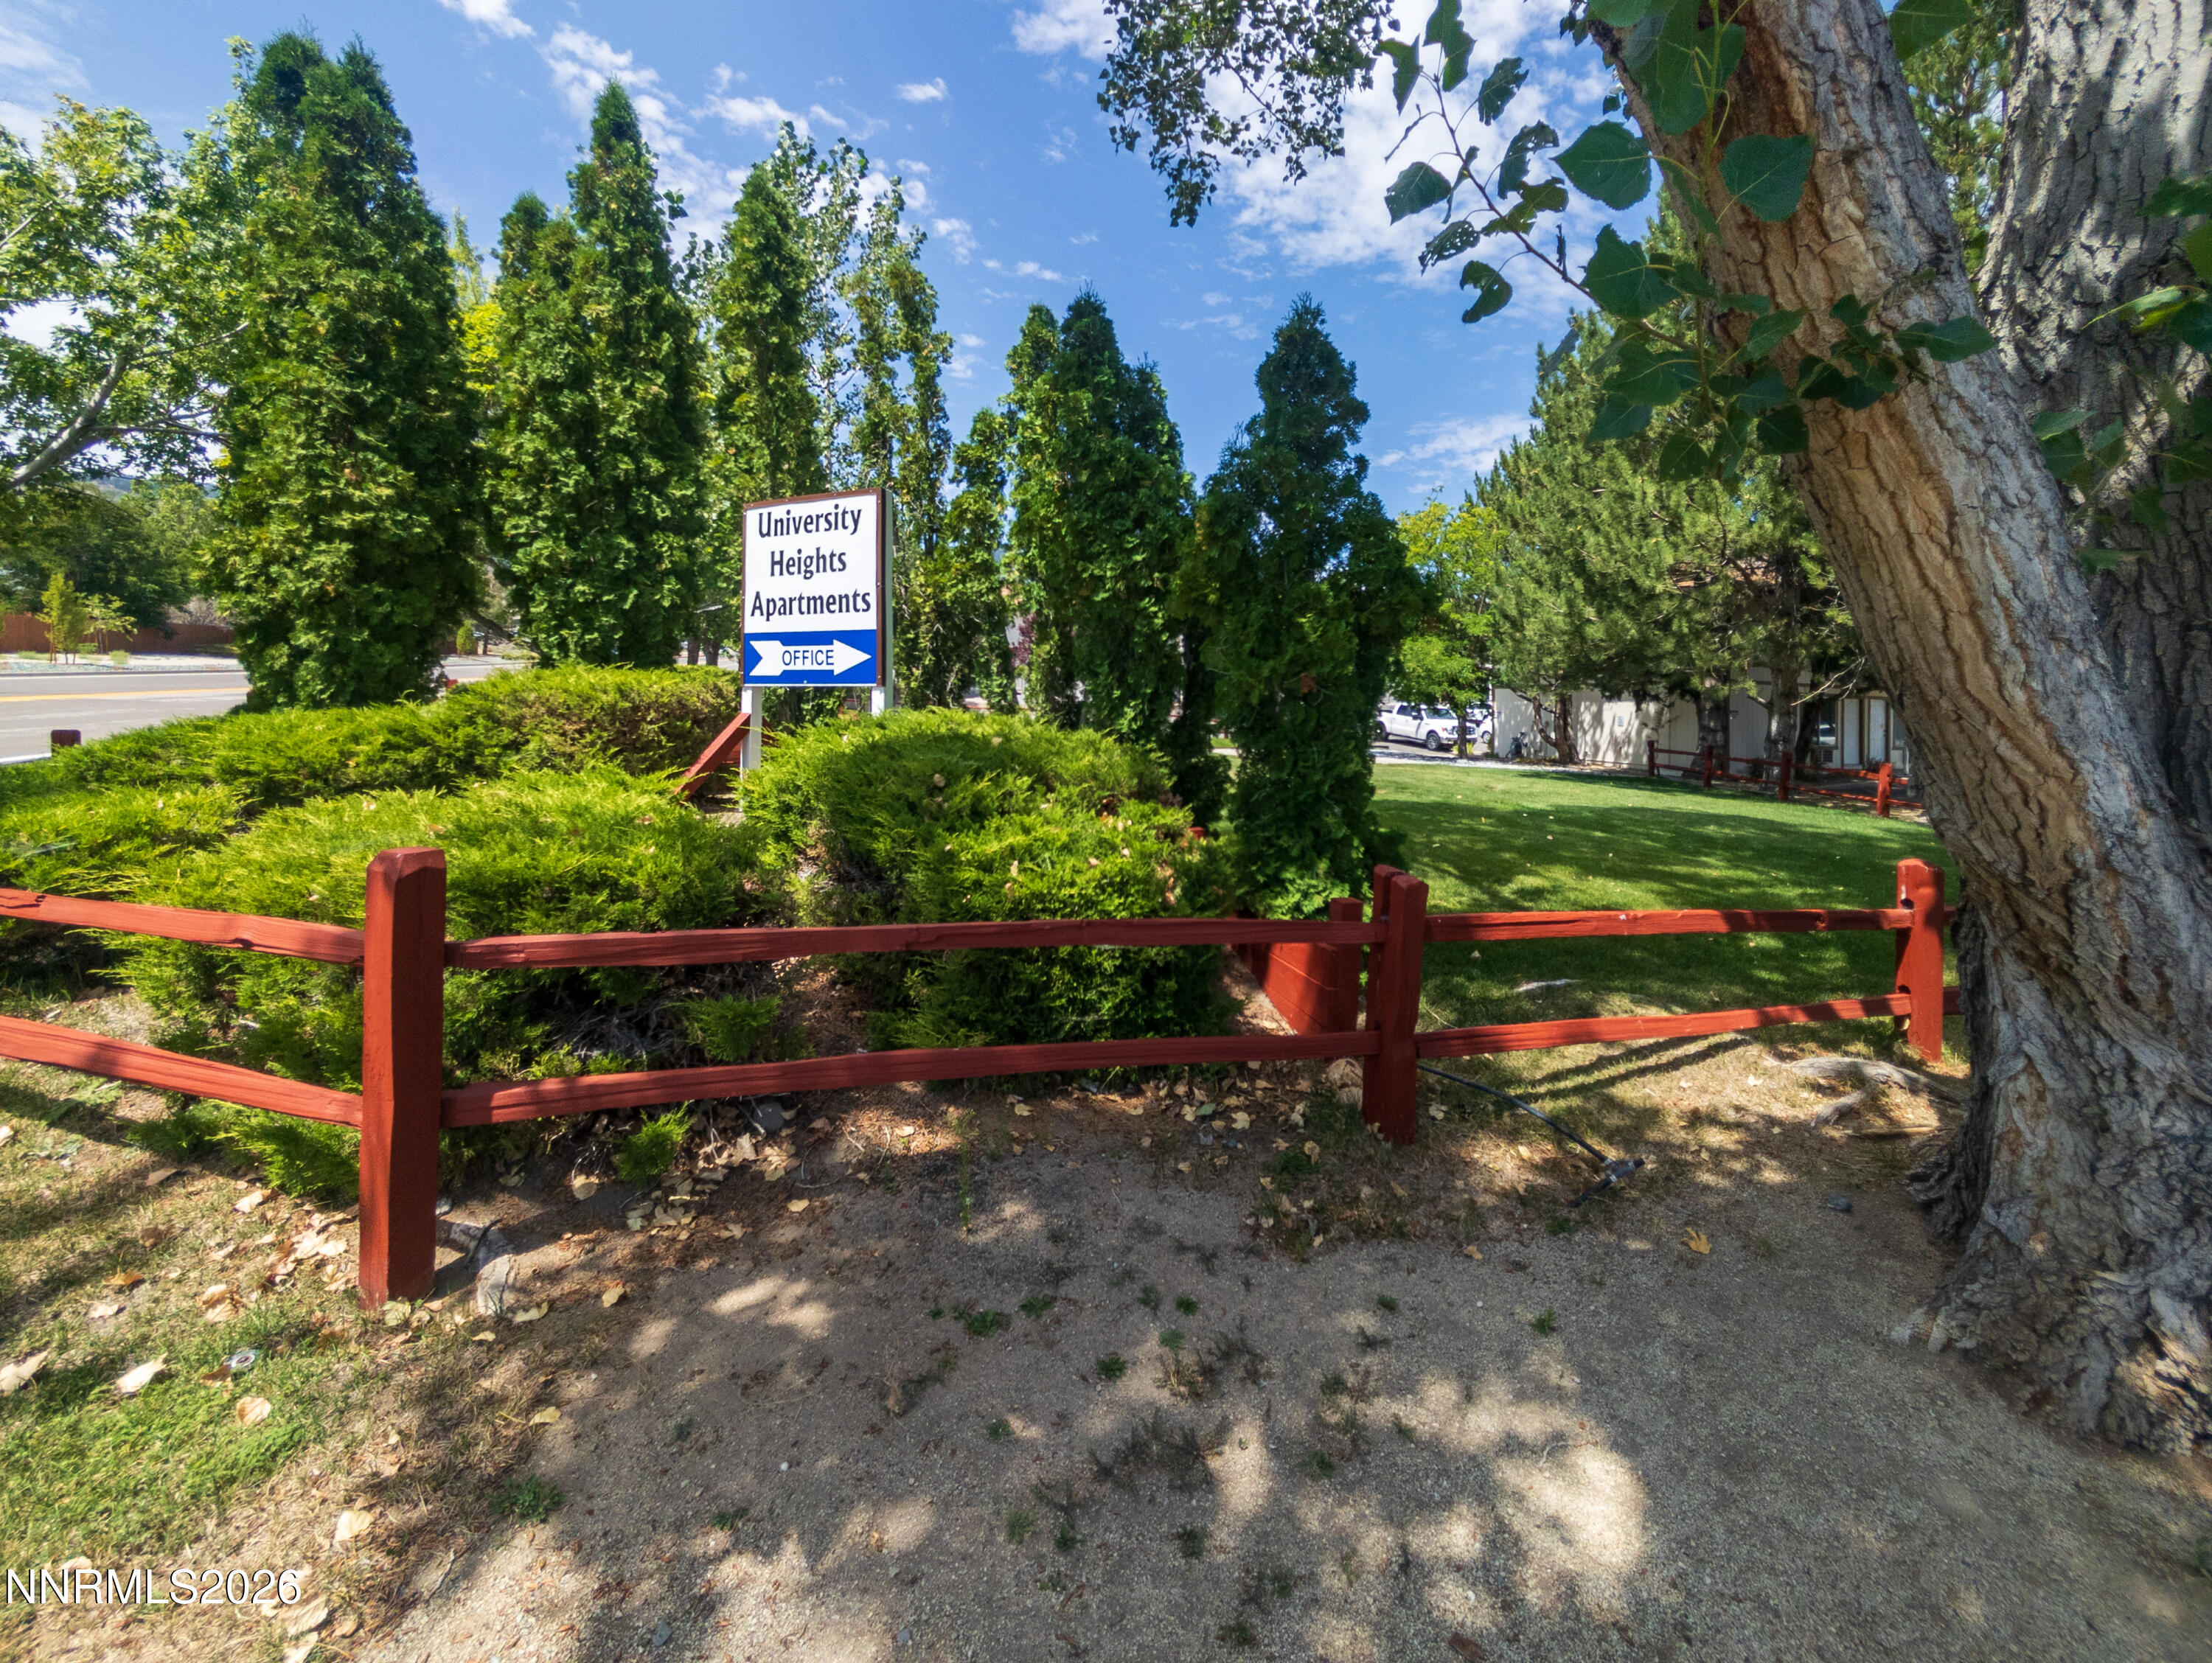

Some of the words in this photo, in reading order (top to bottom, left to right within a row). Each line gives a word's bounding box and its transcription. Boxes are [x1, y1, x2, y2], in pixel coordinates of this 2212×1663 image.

[759, 504, 861, 537] University
[770, 547, 846, 579] Heights
[751, 589, 871, 621] Apartments
[782, 649, 834, 666] OFFICE
